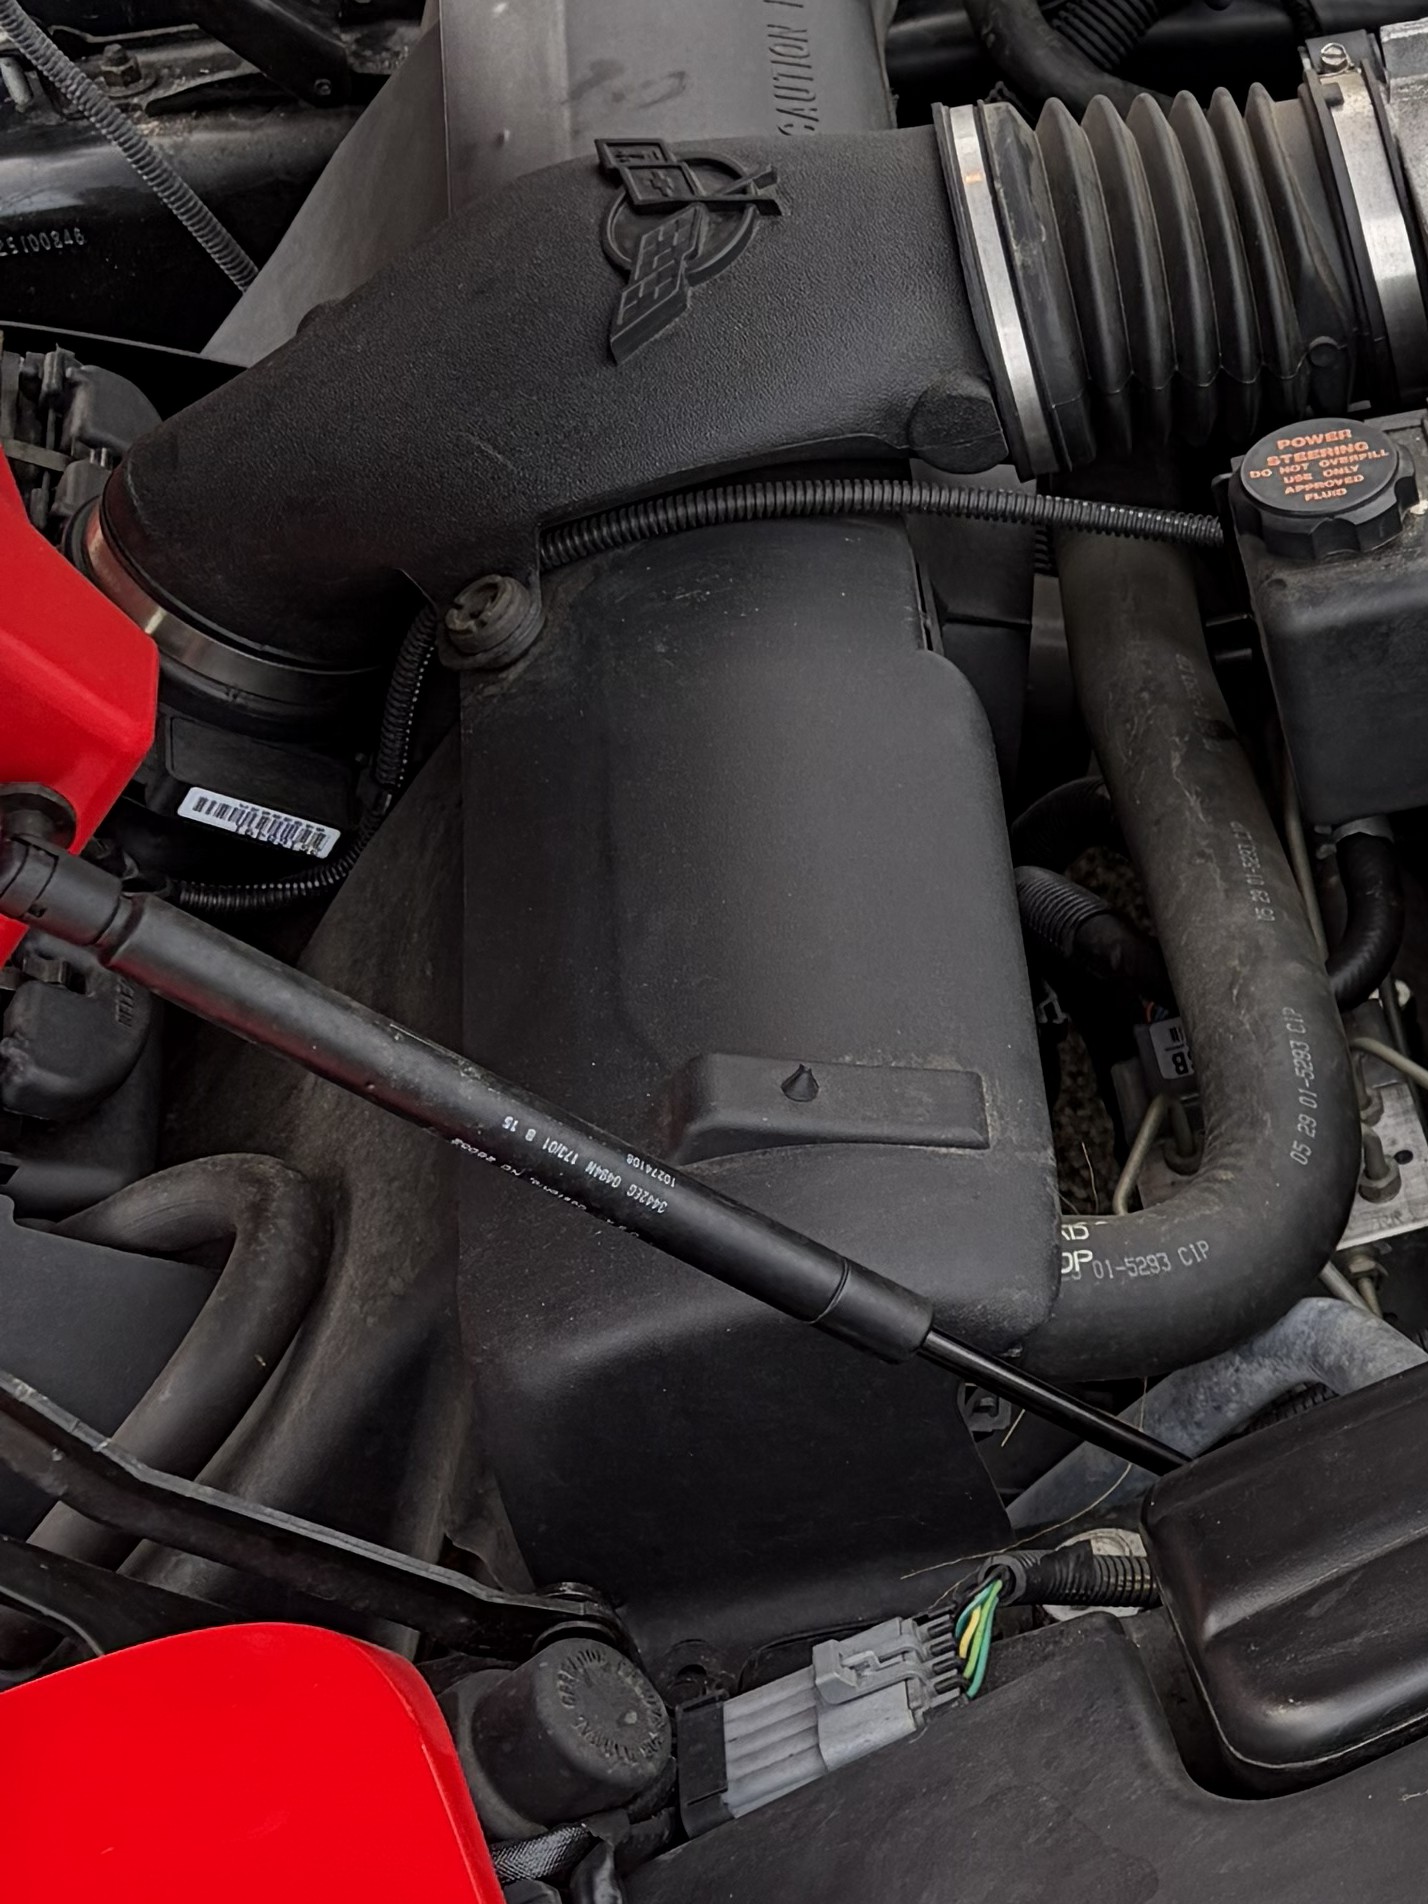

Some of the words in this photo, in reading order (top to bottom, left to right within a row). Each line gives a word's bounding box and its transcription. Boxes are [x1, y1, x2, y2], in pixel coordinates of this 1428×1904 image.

[1277, 429, 1352, 450] POWER
[1250, 468, 1272, 479] DO
[1279, 463, 1310, 475] NOT
[1319, 449, 1390, 468] OVERFILL
[1267, 441, 1369, 467] STEERING
[1283, 473, 1313, 484] USE
[1323, 464, 1360, 477] ONLY
[1284, 474, 1364, 495] APPROVED
[1304, 488, 1347, 502] FLUID
[1290, 1139, 1312, 1165] 05
[1092, 1251, 1172, 1280] 01-5293
